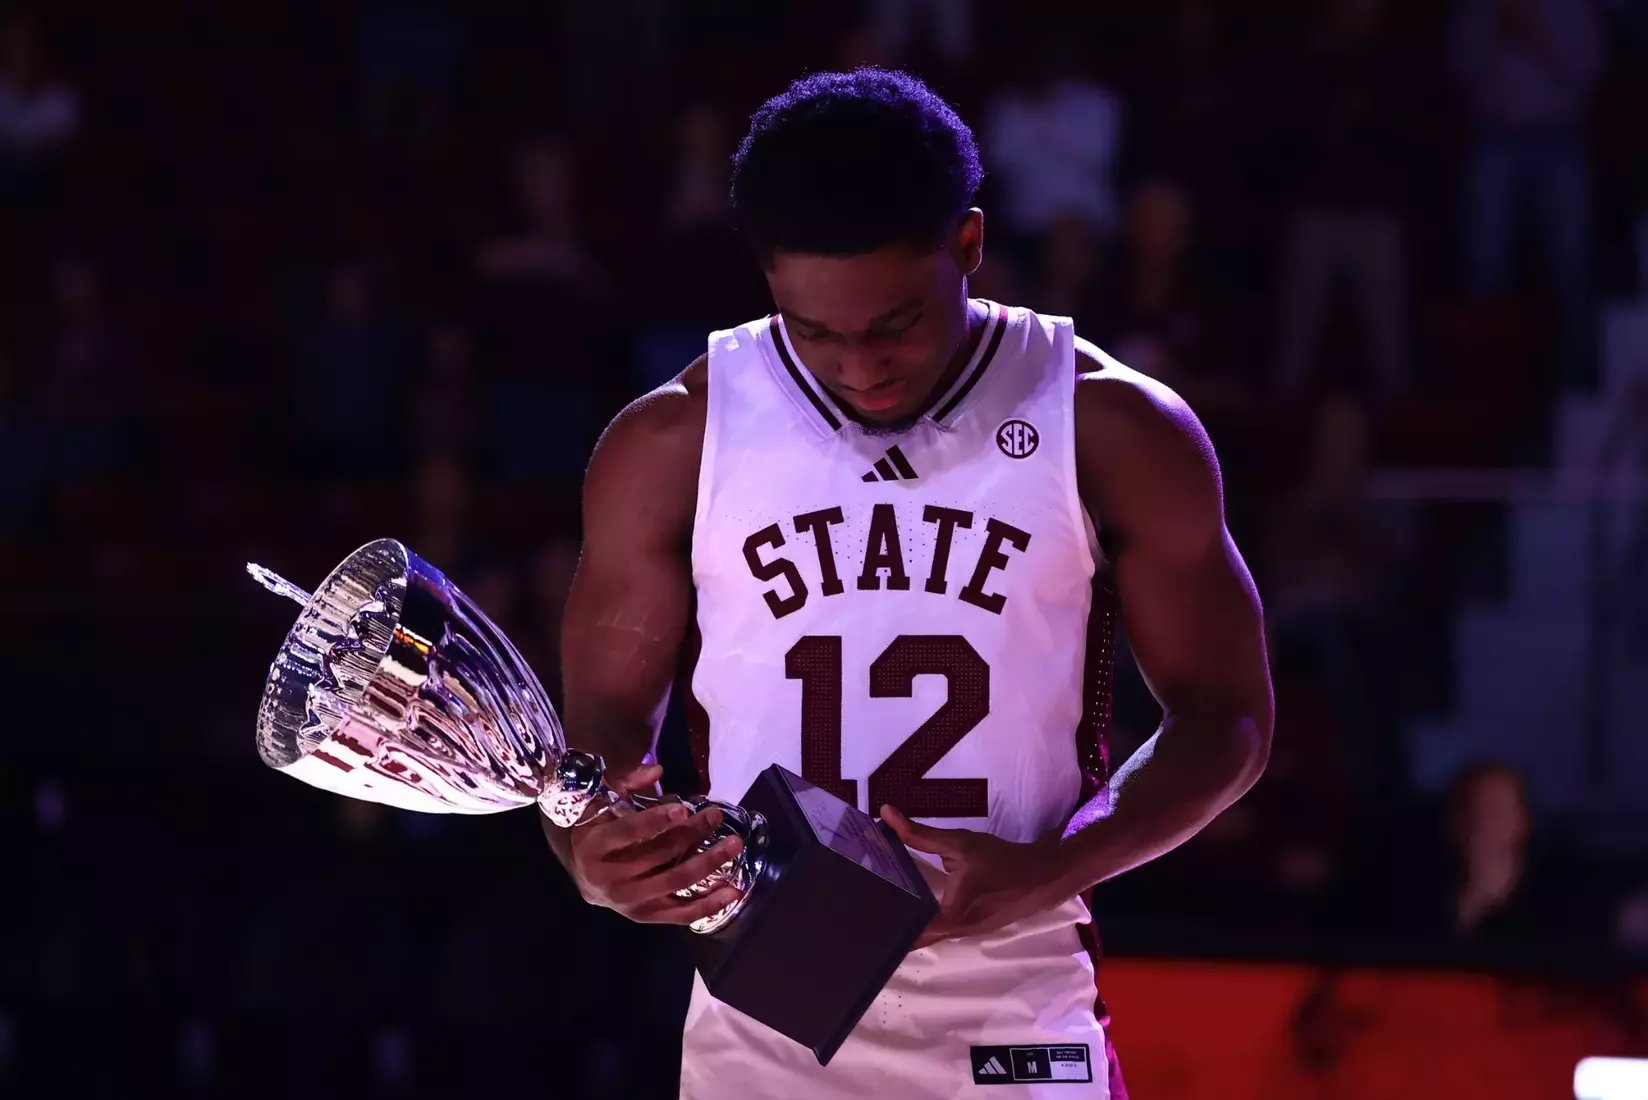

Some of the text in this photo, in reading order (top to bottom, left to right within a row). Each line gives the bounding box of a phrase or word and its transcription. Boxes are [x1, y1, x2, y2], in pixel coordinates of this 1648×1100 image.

[1000, 423, 1035, 455] SEC
[742, 504, 1032, 619] STATE
[785, 635, 990, 817] 12
[1027, 1061, 1038, 1074] M
